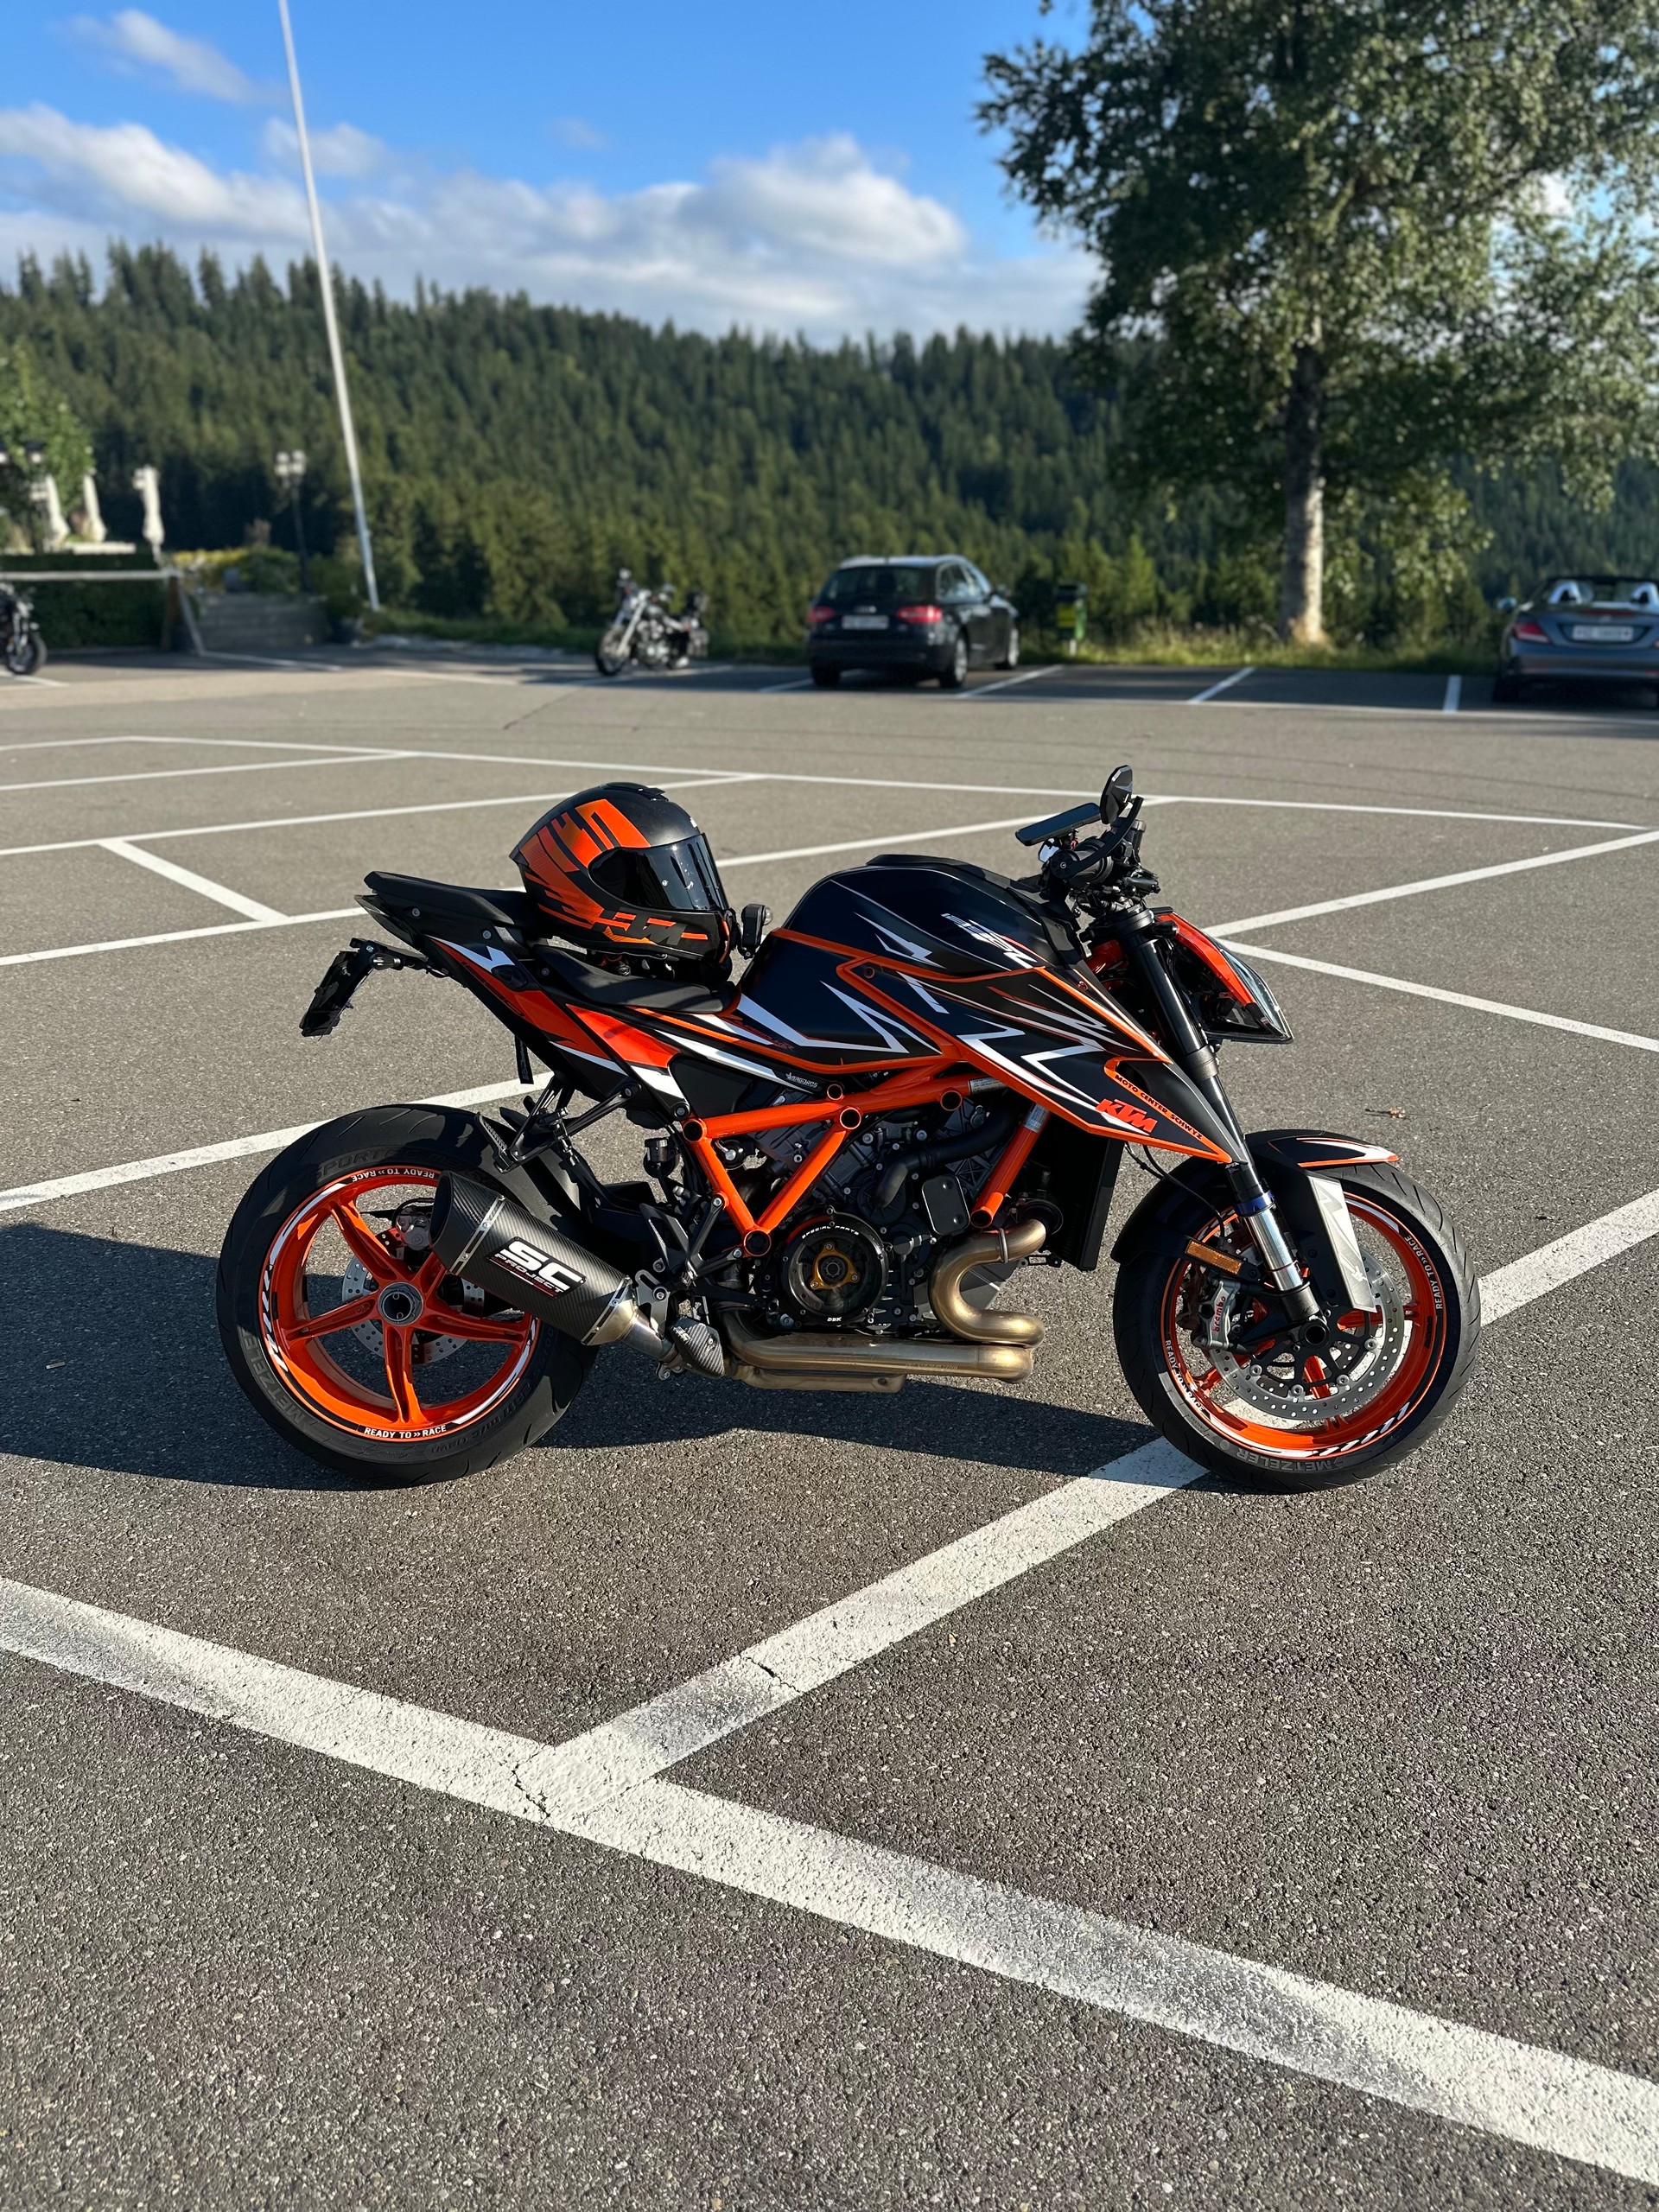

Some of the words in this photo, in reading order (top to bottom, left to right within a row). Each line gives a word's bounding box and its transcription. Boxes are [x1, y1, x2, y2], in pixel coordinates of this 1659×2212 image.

[1096, 1098, 1158, 1133] KTM
[1115, 1074, 1138, 1093] MOTO
[1141, 1092, 1167, 1115] CENTER
[1170, 1115, 1202, 1140] SCHWYZ
[352, 1170, 377, 1182] RACE
[404, 1168, 435, 1179] READY
[802, 1226, 831, 1239] SPECIAL
[835, 1225, 859, 1236] PARTS
[1404, 1236, 1424, 1257] RACE
[494, 1253, 564, 1293] PROJECT
[500, 1241, 582, 1291] SC
[1424, 1265, 1434, 1277] TO
[1430, 1280, 1443, 1309] READY
[1212, 1296, 1226, 1332] brembo
[1165, 1339, 1179, 1370] READY
[364, 1427, 397, 1439] READY
[422, 1424, 447, 1437] RACE
[1235, 1447, 1332, 1471] METZELER
